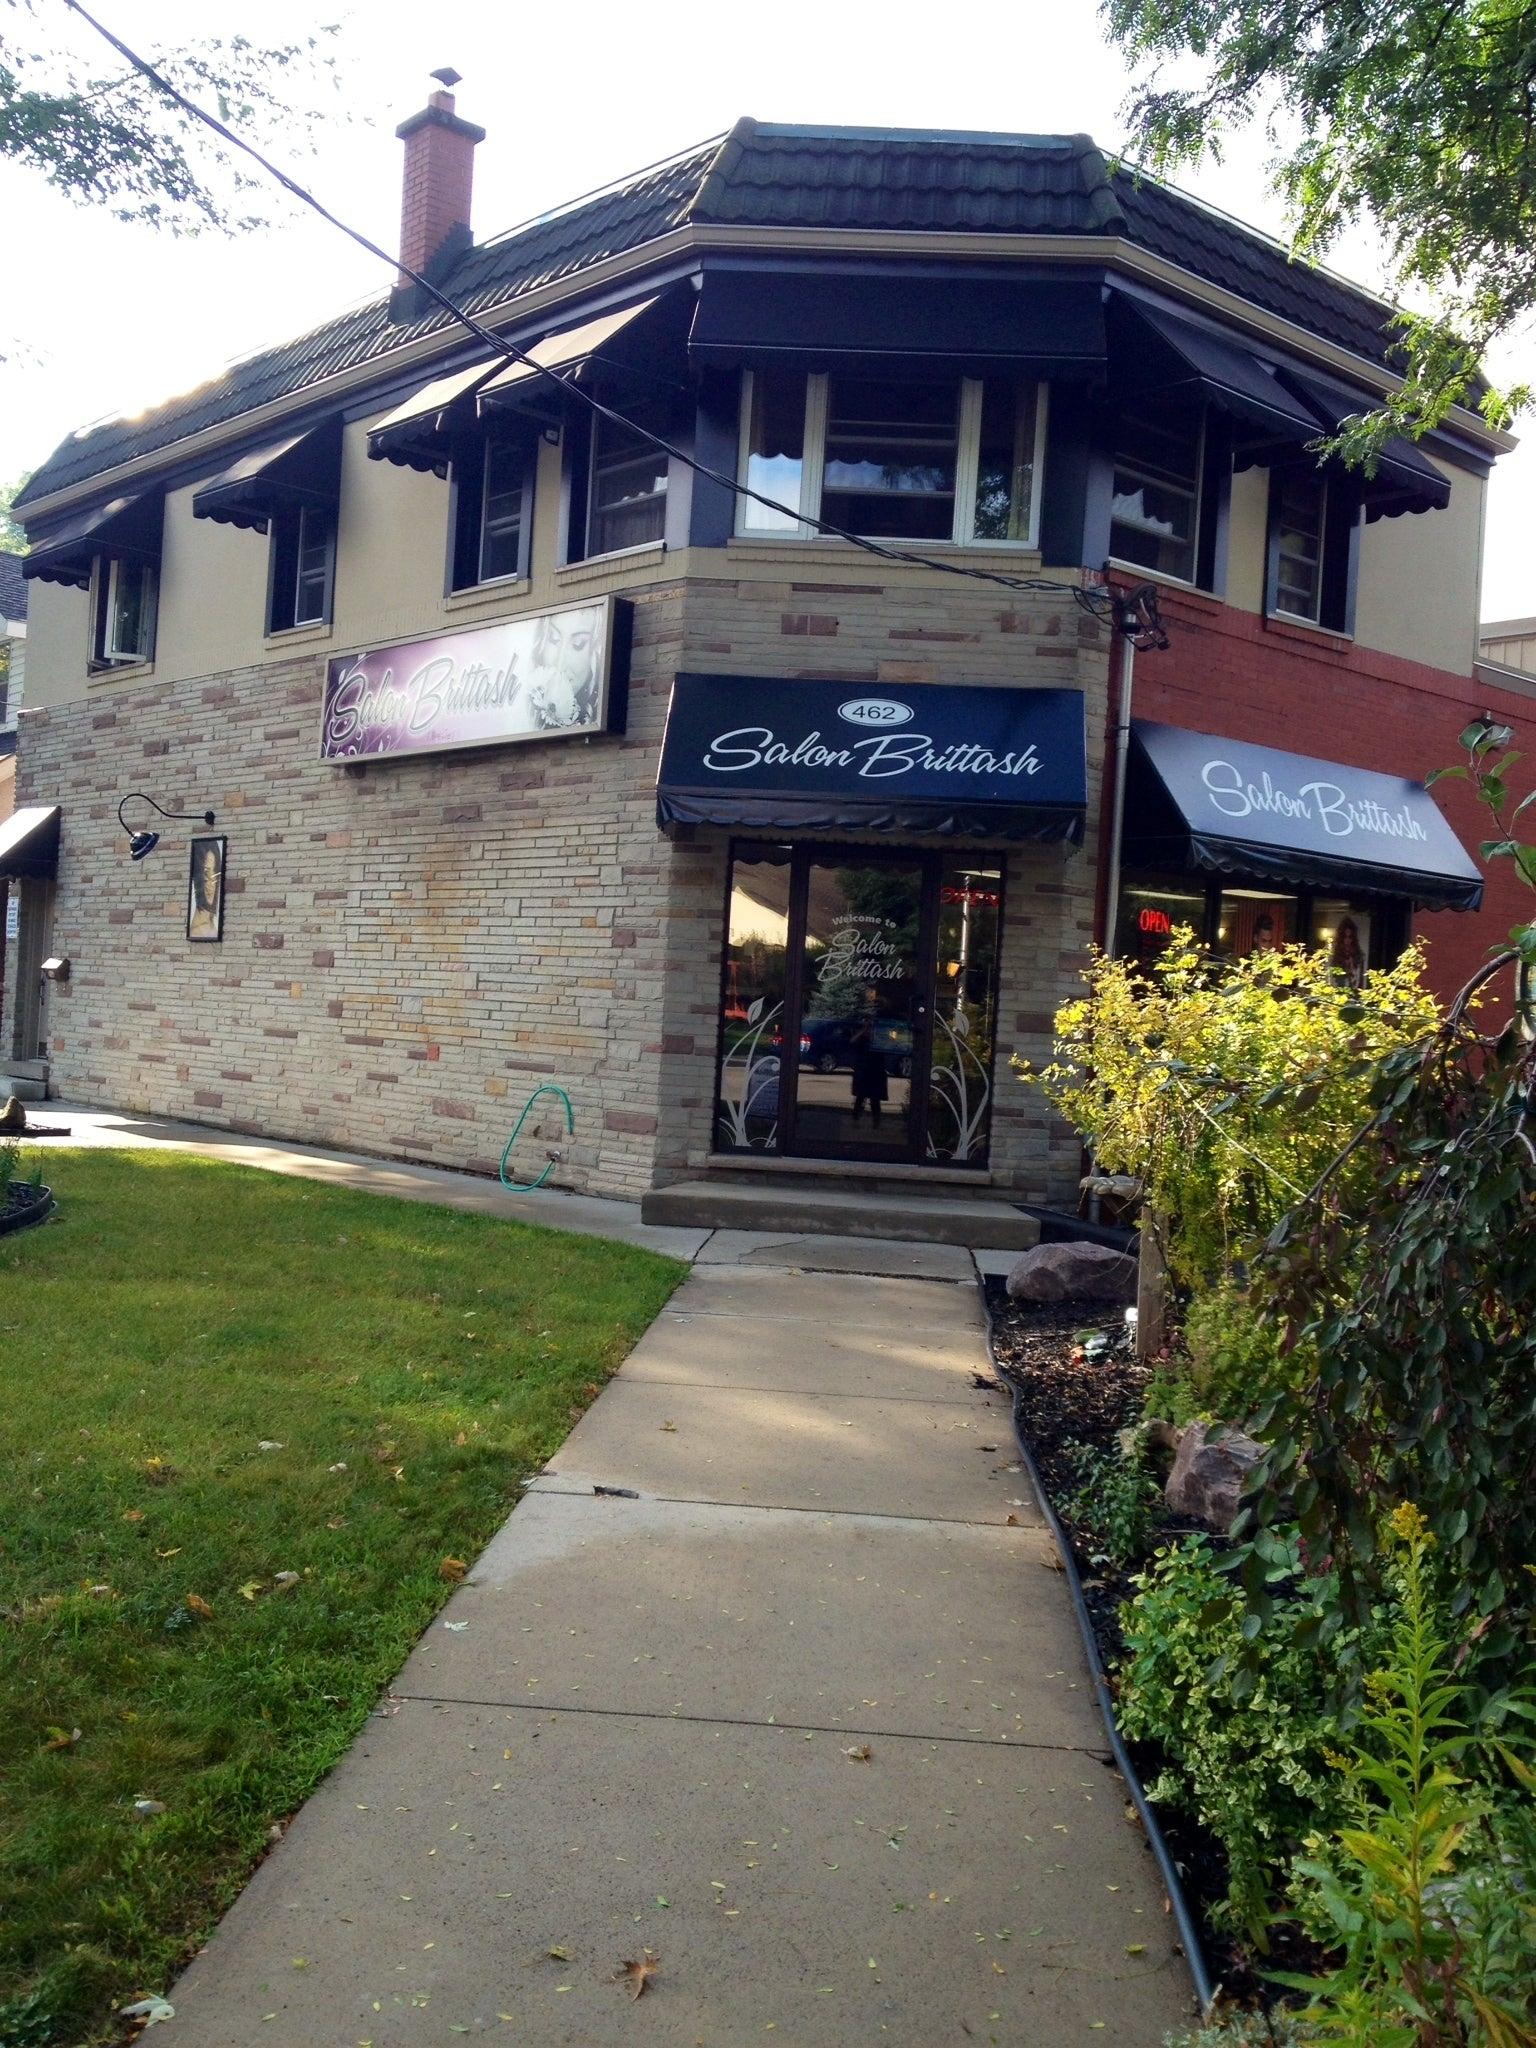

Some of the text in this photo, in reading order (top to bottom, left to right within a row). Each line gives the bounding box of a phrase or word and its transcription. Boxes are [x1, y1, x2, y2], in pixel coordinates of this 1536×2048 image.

[330, 652, 522, 741] Salon Brittash
[851, 705, 896, 721] 462
[702, 727, 1044, 778] Salon Brittash
[1201, 760, 1427, 842] Salon Brittash
[832, 914, 897, 929] Welcome to
[1140, 908, 1170, 934] OPEN
[832, 928, 897, 956] Salon
[814, 951, 905, 982] Brittash
